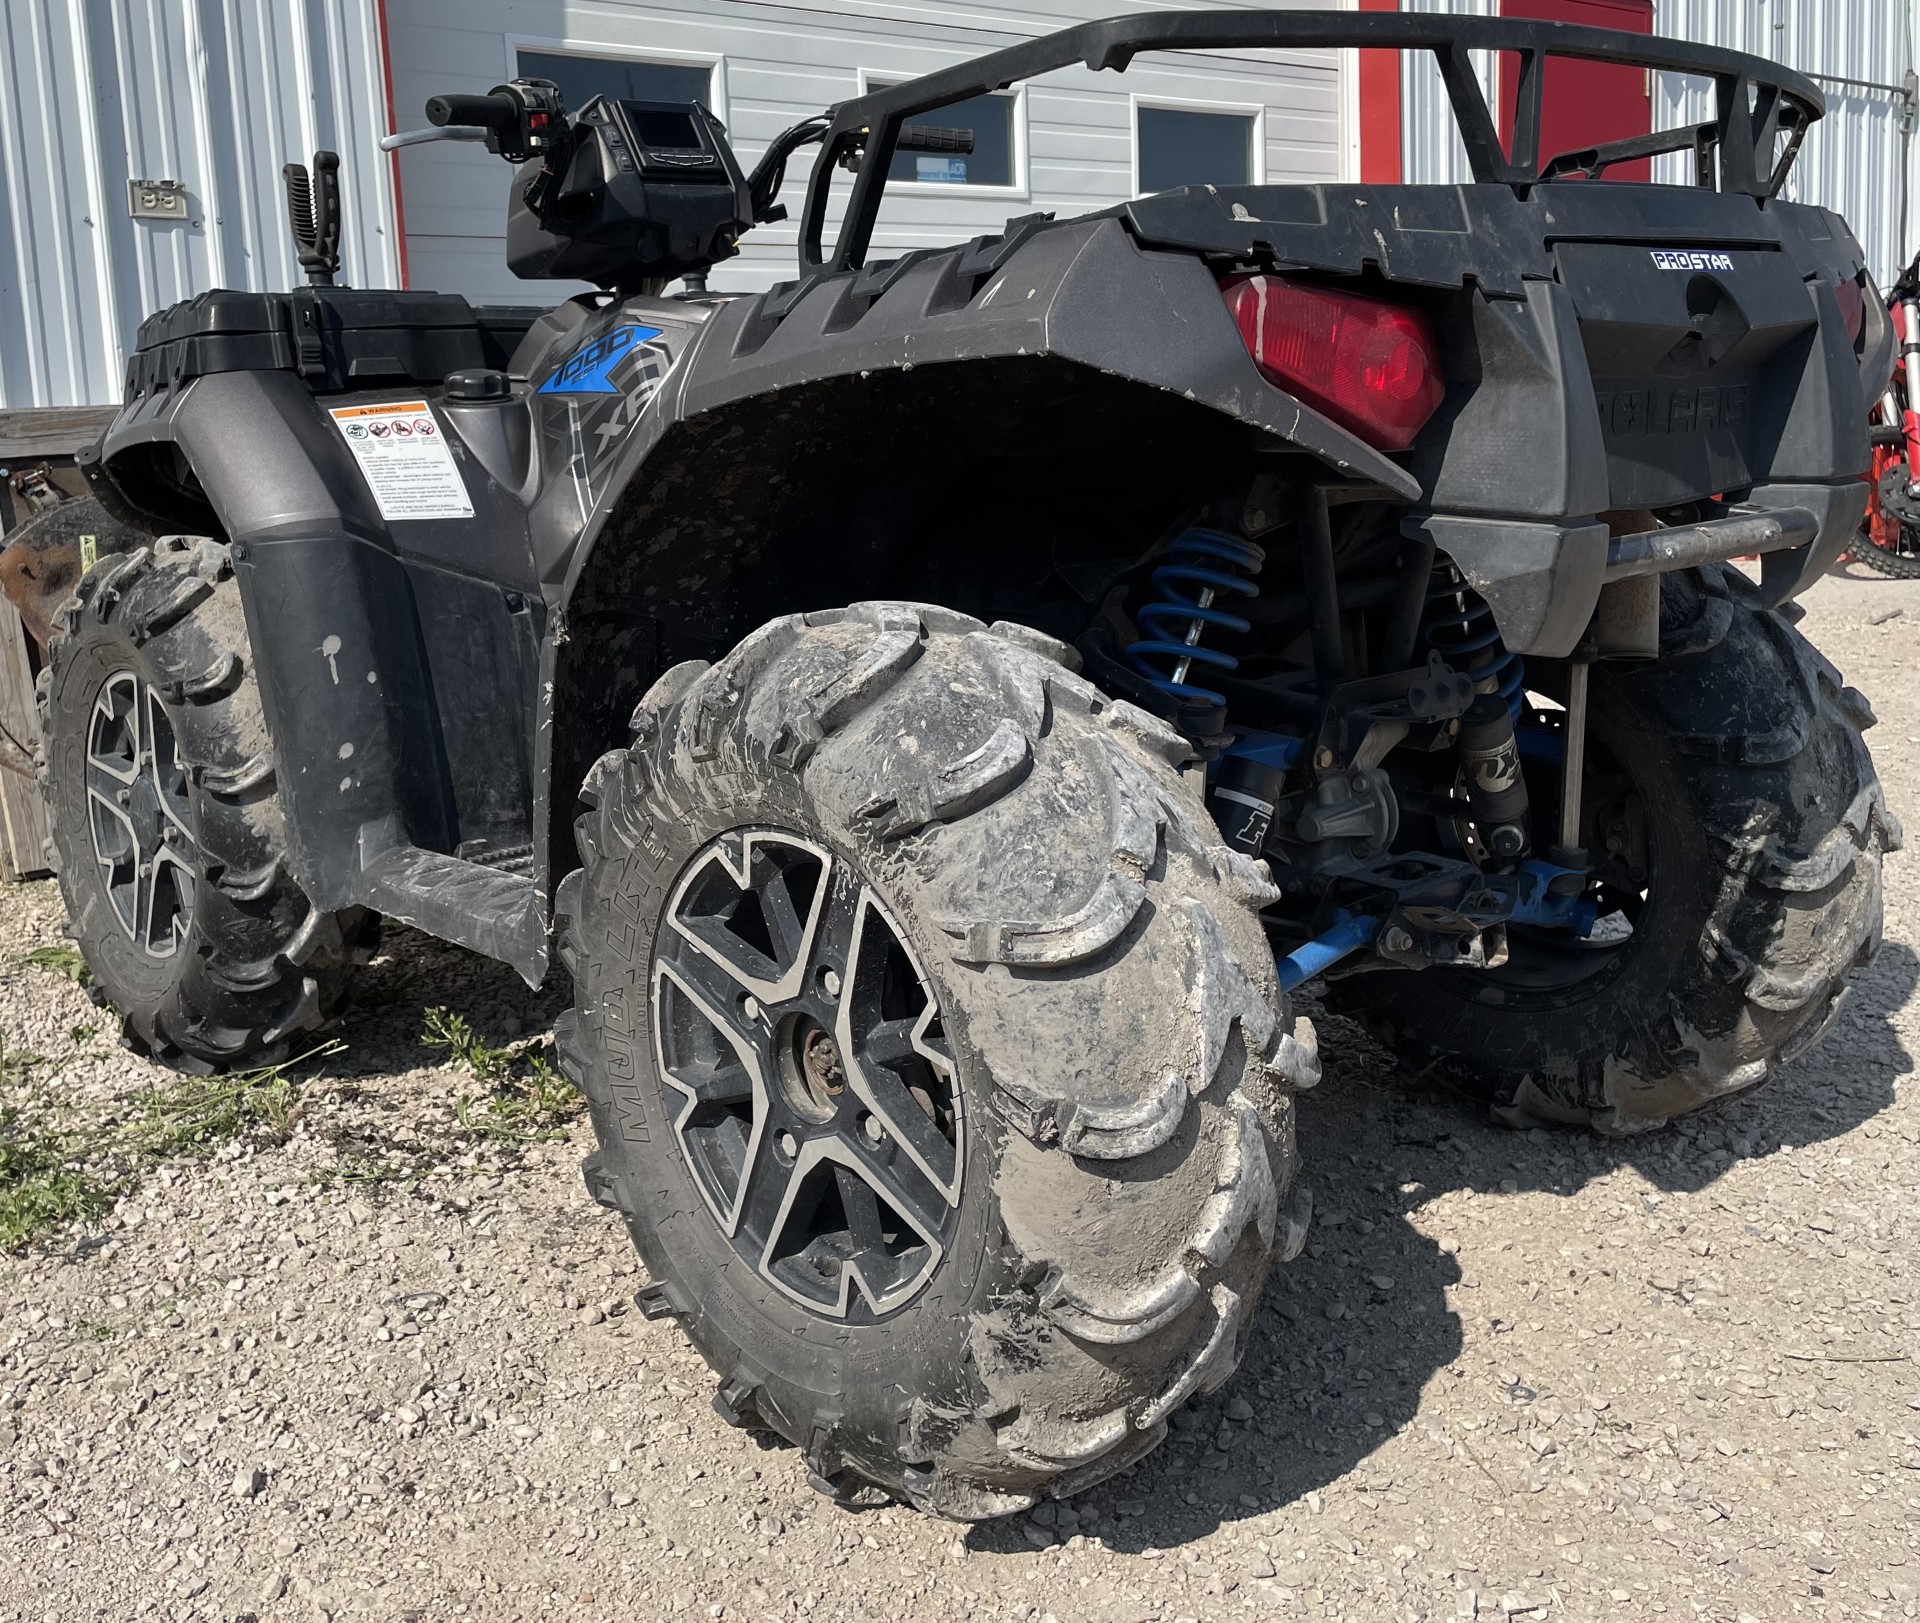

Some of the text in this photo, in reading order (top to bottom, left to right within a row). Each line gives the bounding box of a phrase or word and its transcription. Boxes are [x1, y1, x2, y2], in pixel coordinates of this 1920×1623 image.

[1650, 251, 1734, 270] PROSTAR
[554, 328, 634, 388] 1000
[637, 952, 648, 979] THE
[637, 982, 646, 996] IN
[637, 998, 647, 1039] MADE
[602, 987, 651, 1143] MUD
